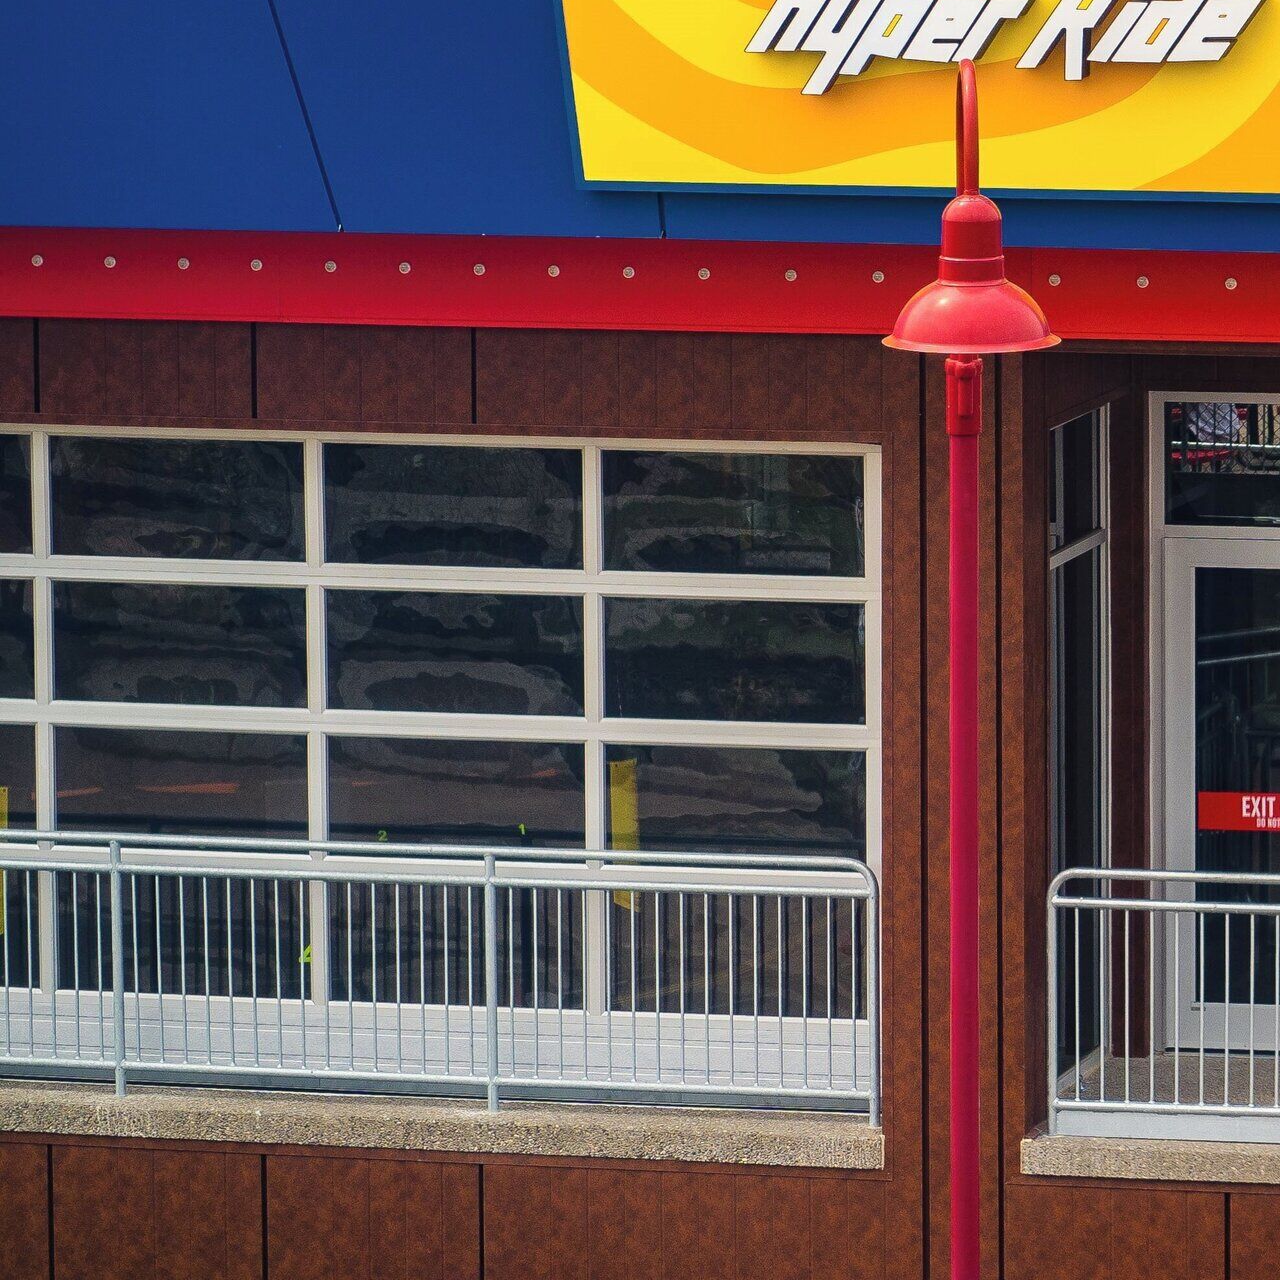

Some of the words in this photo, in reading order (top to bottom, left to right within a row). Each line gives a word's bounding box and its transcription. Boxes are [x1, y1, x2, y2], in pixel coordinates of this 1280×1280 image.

[1241, 795, 1276, 818] EXIT
[1256, 818, 1266, 828] DO
[1267, 818, 1280, 828] NOT
